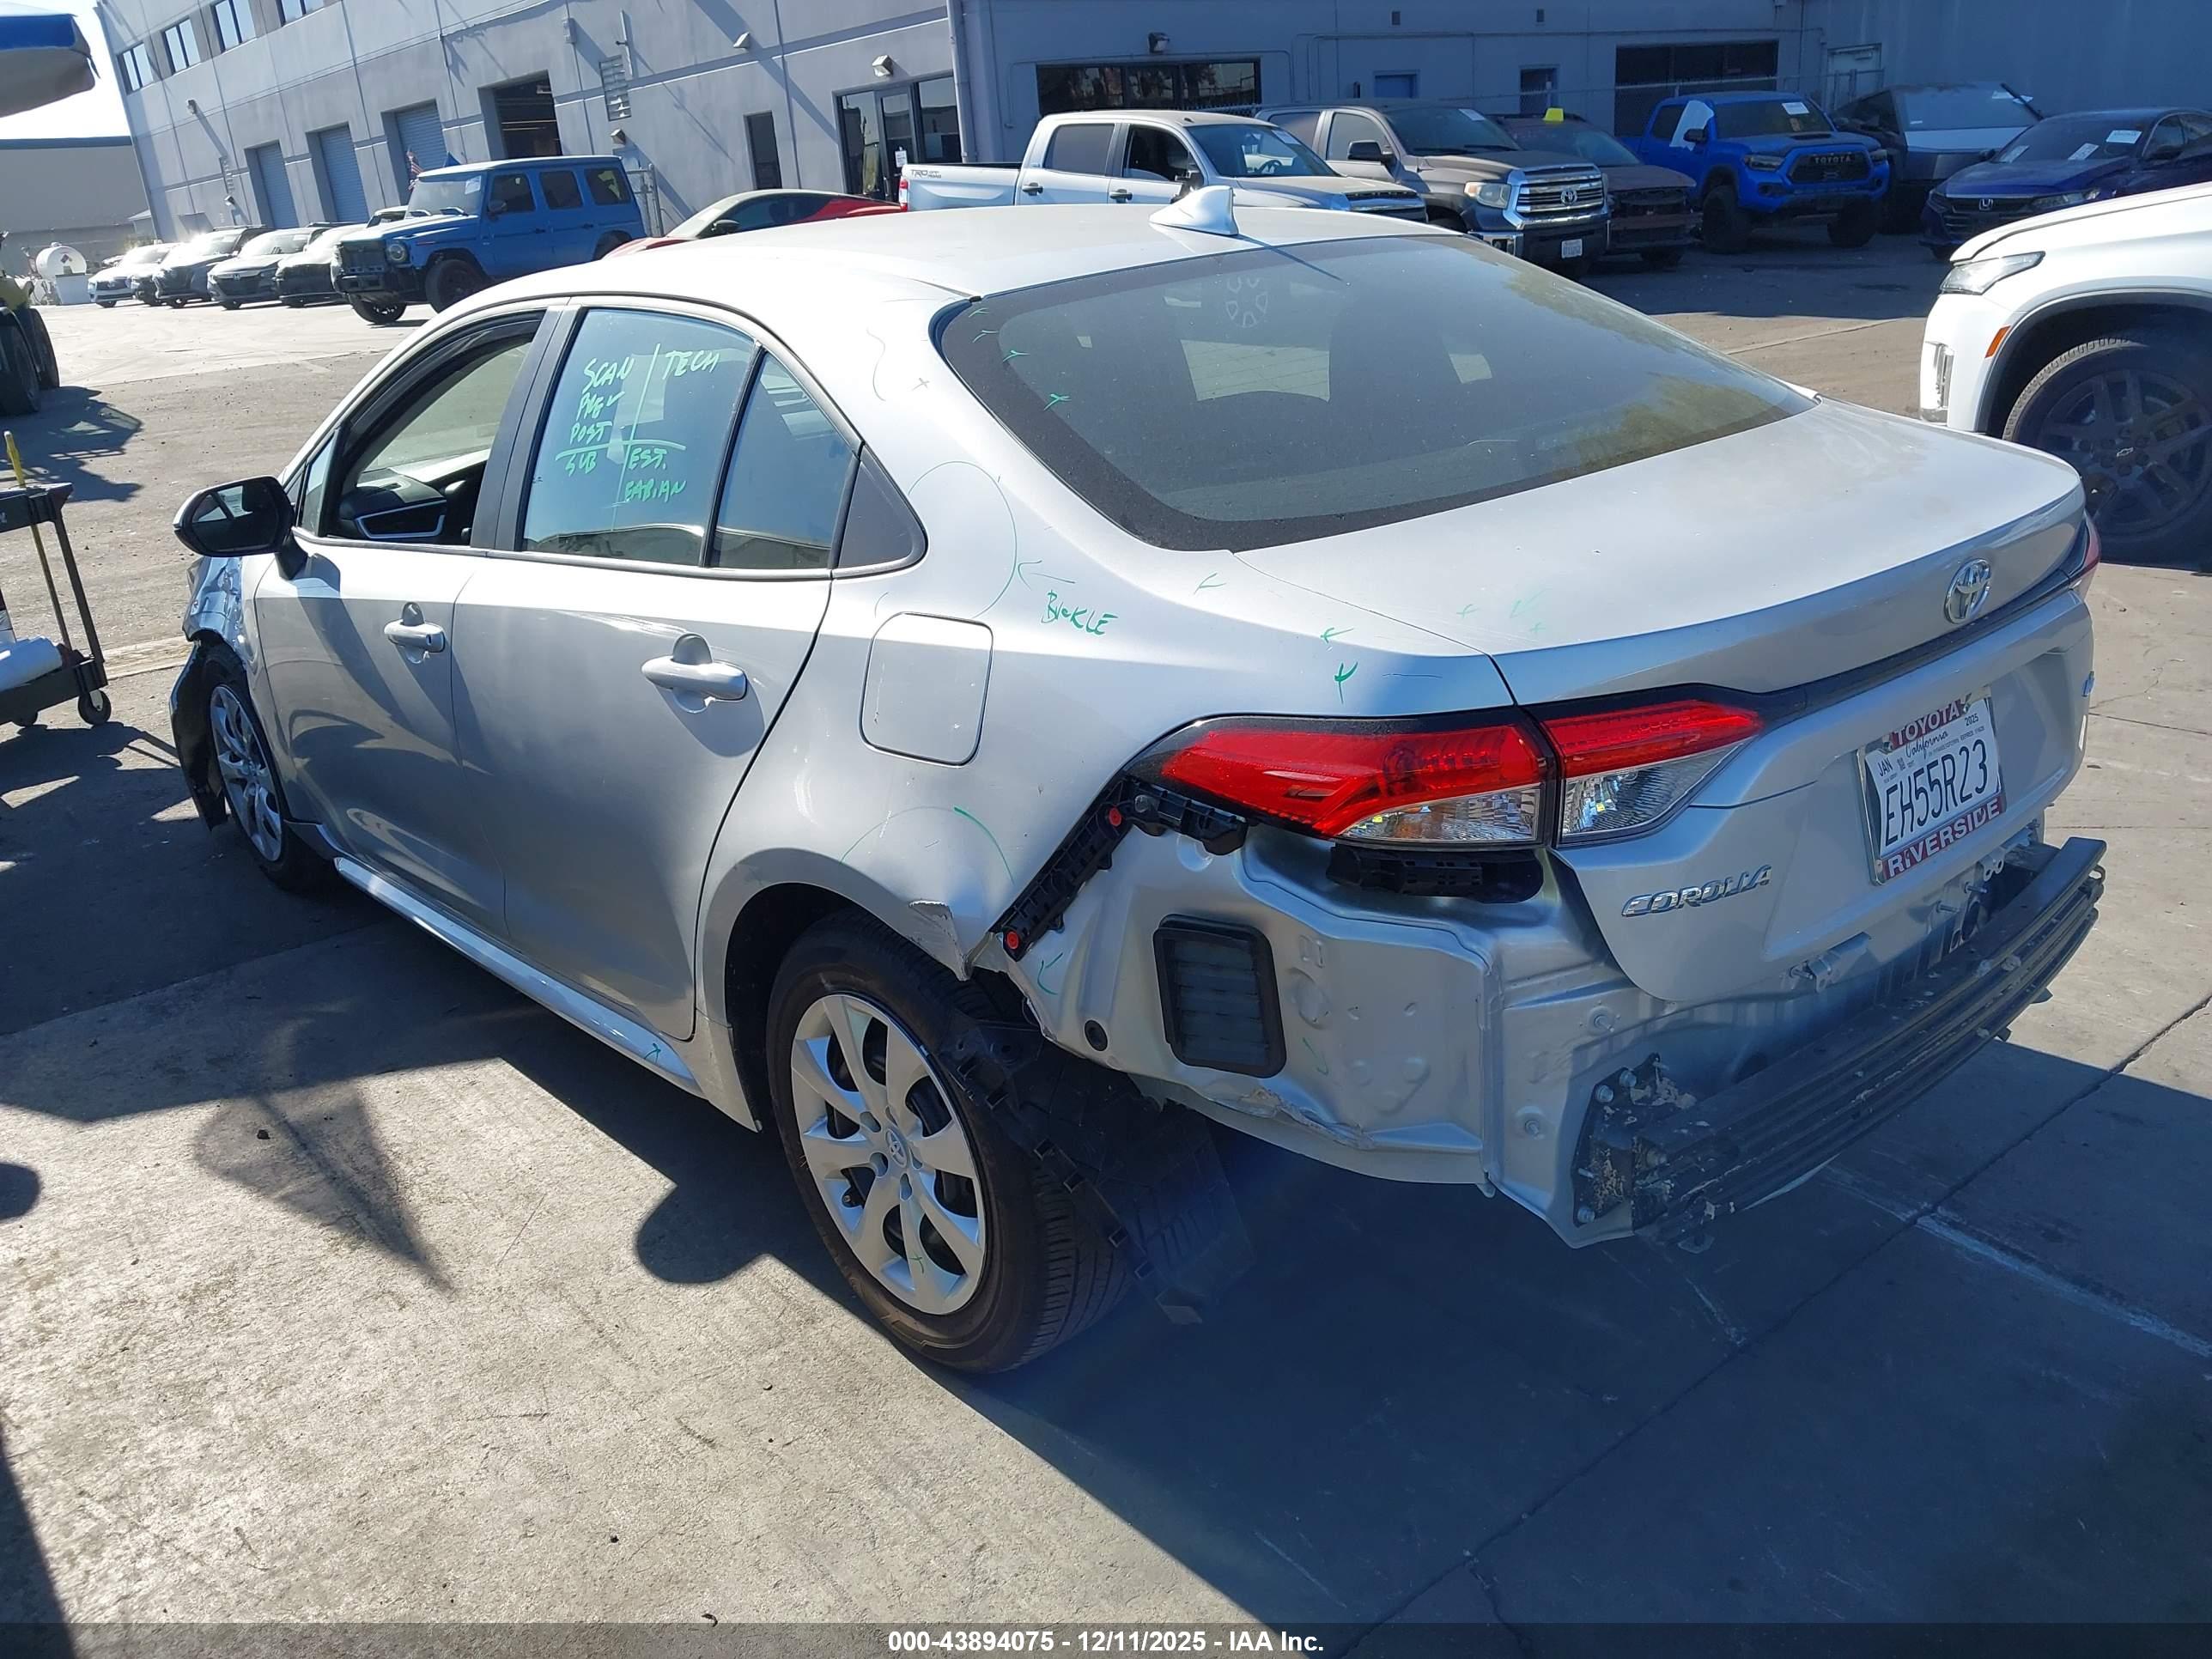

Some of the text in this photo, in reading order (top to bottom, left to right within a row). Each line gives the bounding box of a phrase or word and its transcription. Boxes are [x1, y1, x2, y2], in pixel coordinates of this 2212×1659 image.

[1814, 155, 1851, 165] TOYOTA
[582, 356, 635, 395] SCAN
[662, 349, 720, 380] TECH
[569, 421, 613, 444] POST
[564, 452, 599, 477] SUB
[1895, 700, 1960, 745] TOYOTA
[1964, 713, 1979, 726] 2025
[1905, 730, 1949, 760] California
[1877, 757, 1893, 777] JAN
[1885, 738, 1989, 847] EH55R23
[1887, 798, 2001, 878] RIVERSIDE
[1620, 864, 1772, 918] COROLLA
